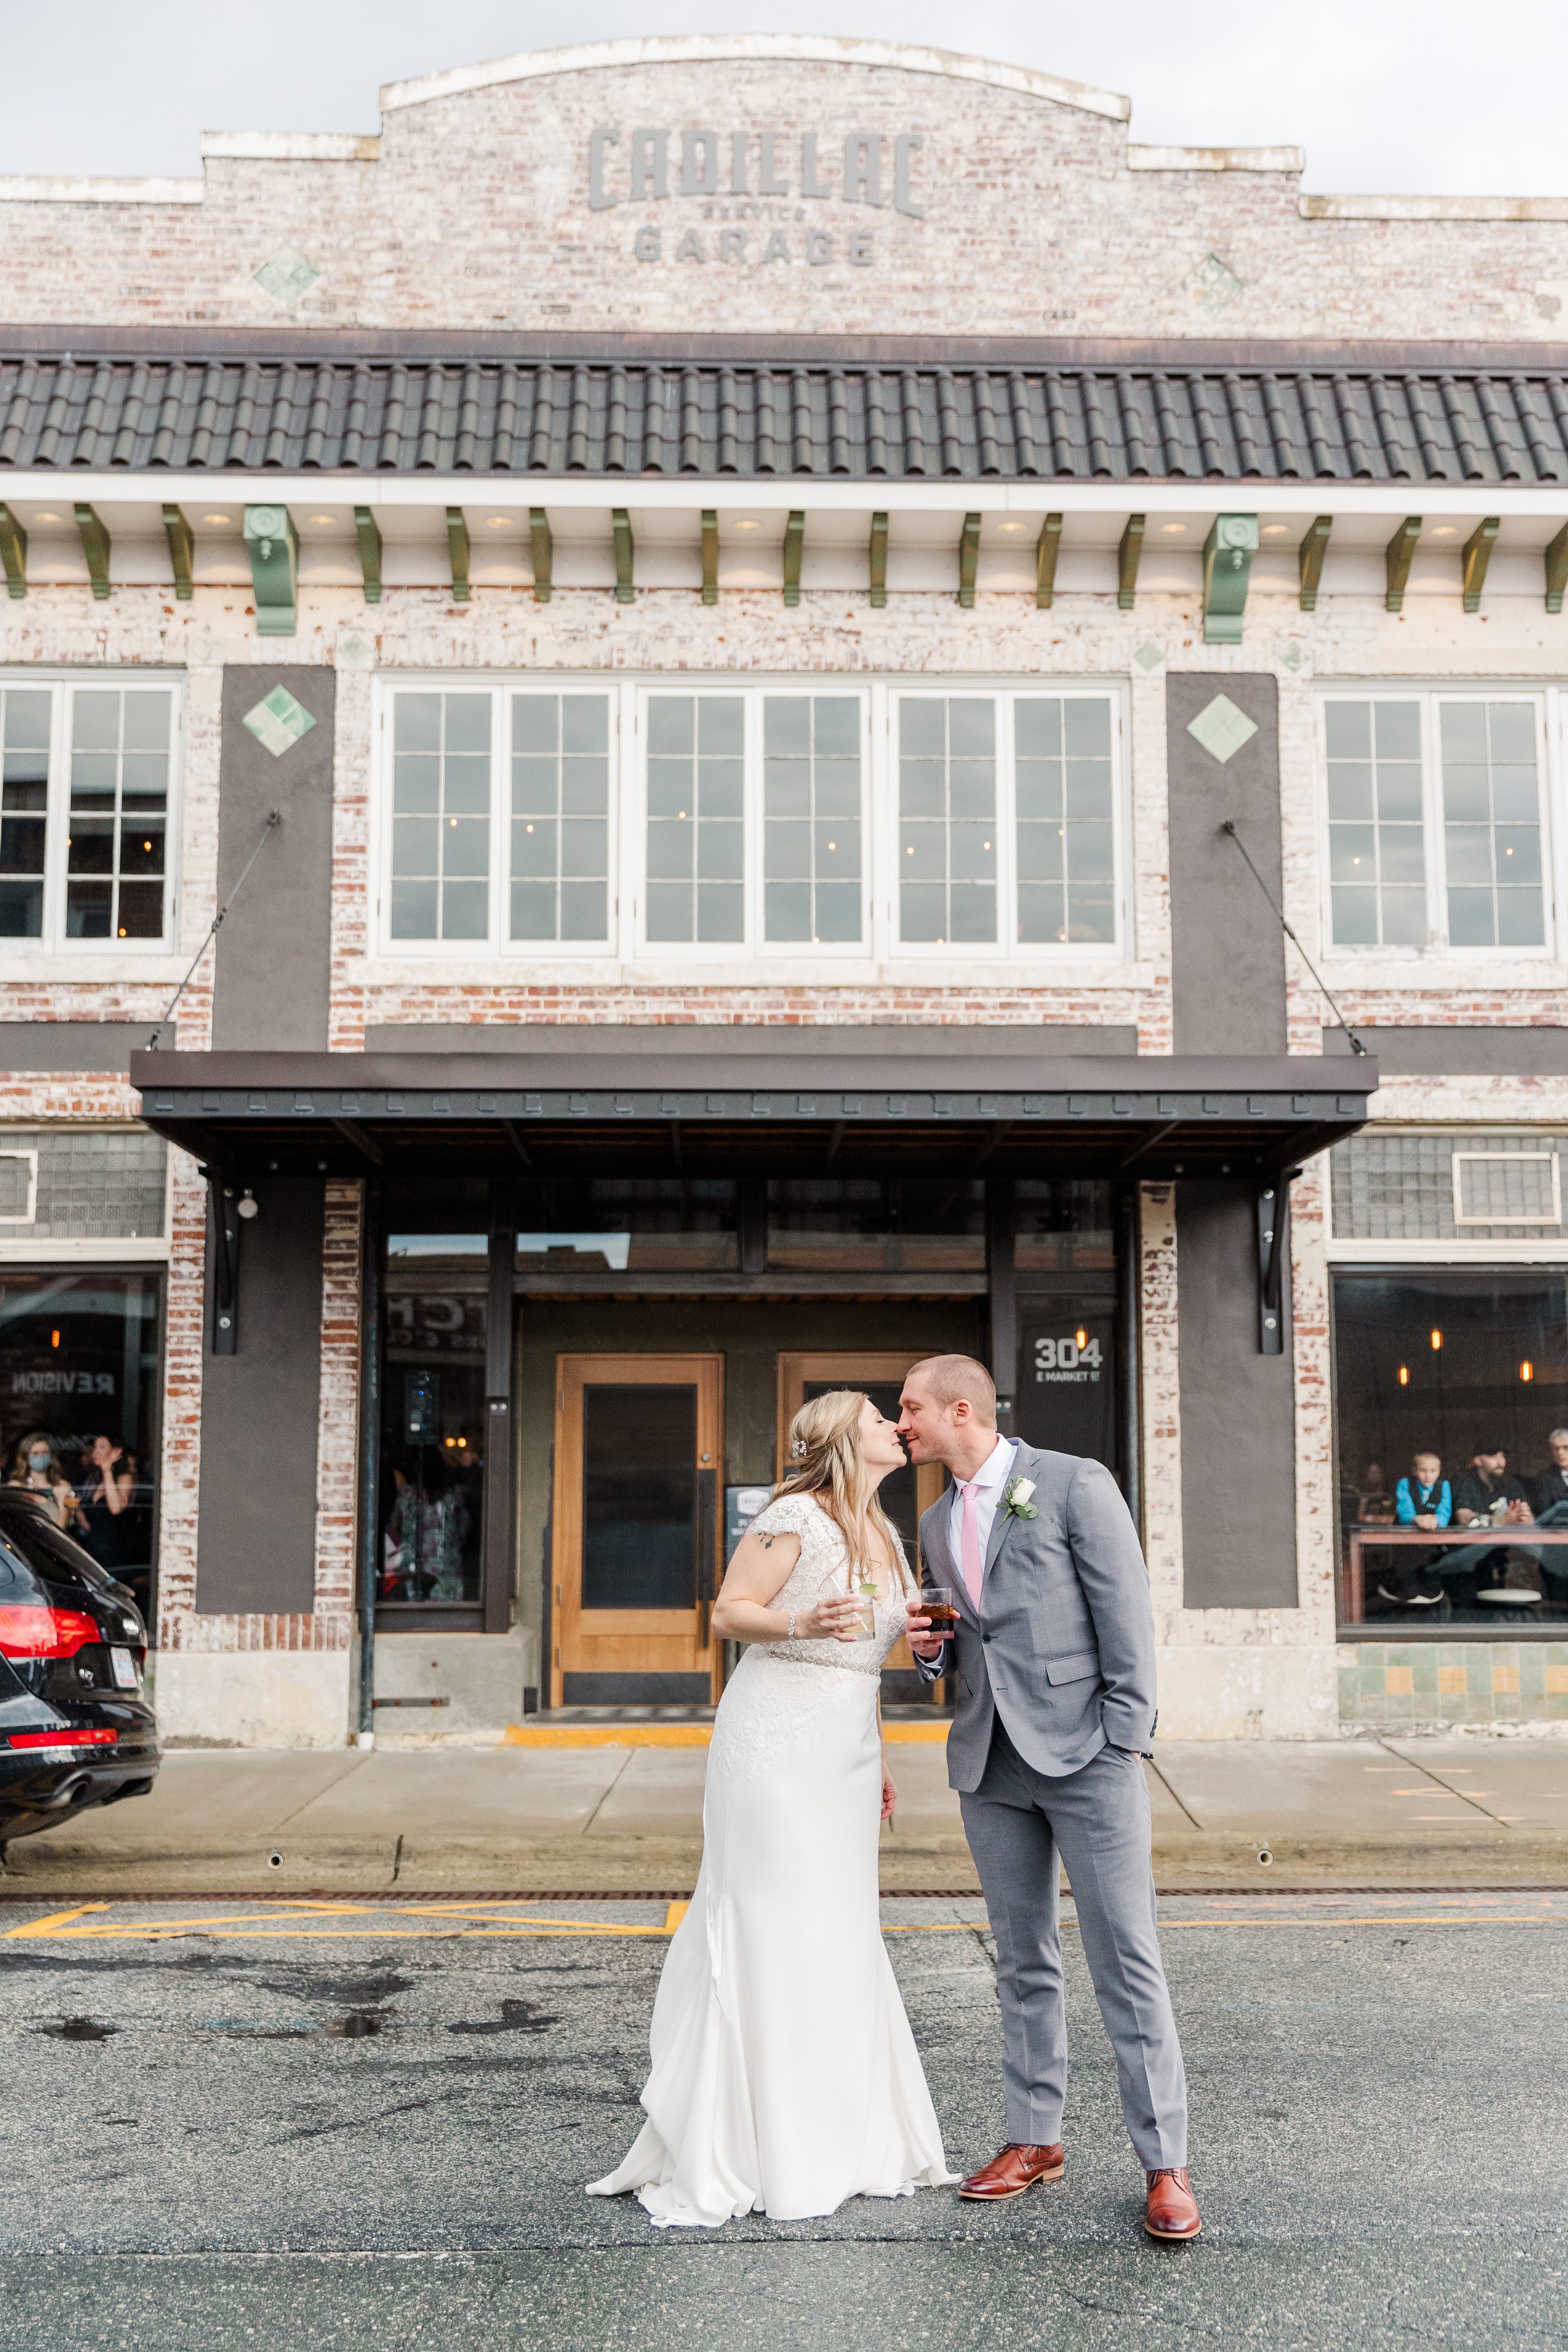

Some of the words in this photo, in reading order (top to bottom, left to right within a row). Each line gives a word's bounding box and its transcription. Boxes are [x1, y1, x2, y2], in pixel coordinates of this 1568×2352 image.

[589, 129, 924, 221] CADILLAC
[703, 207, 806, 222] SERVICE
[634, 226, 874, 267] GARAGE
[1035, 1338, 1103, 1368] 304
[1036, 1371, 1044, 1382] E
[1045, 1371, 1088, 1382] MARKET
